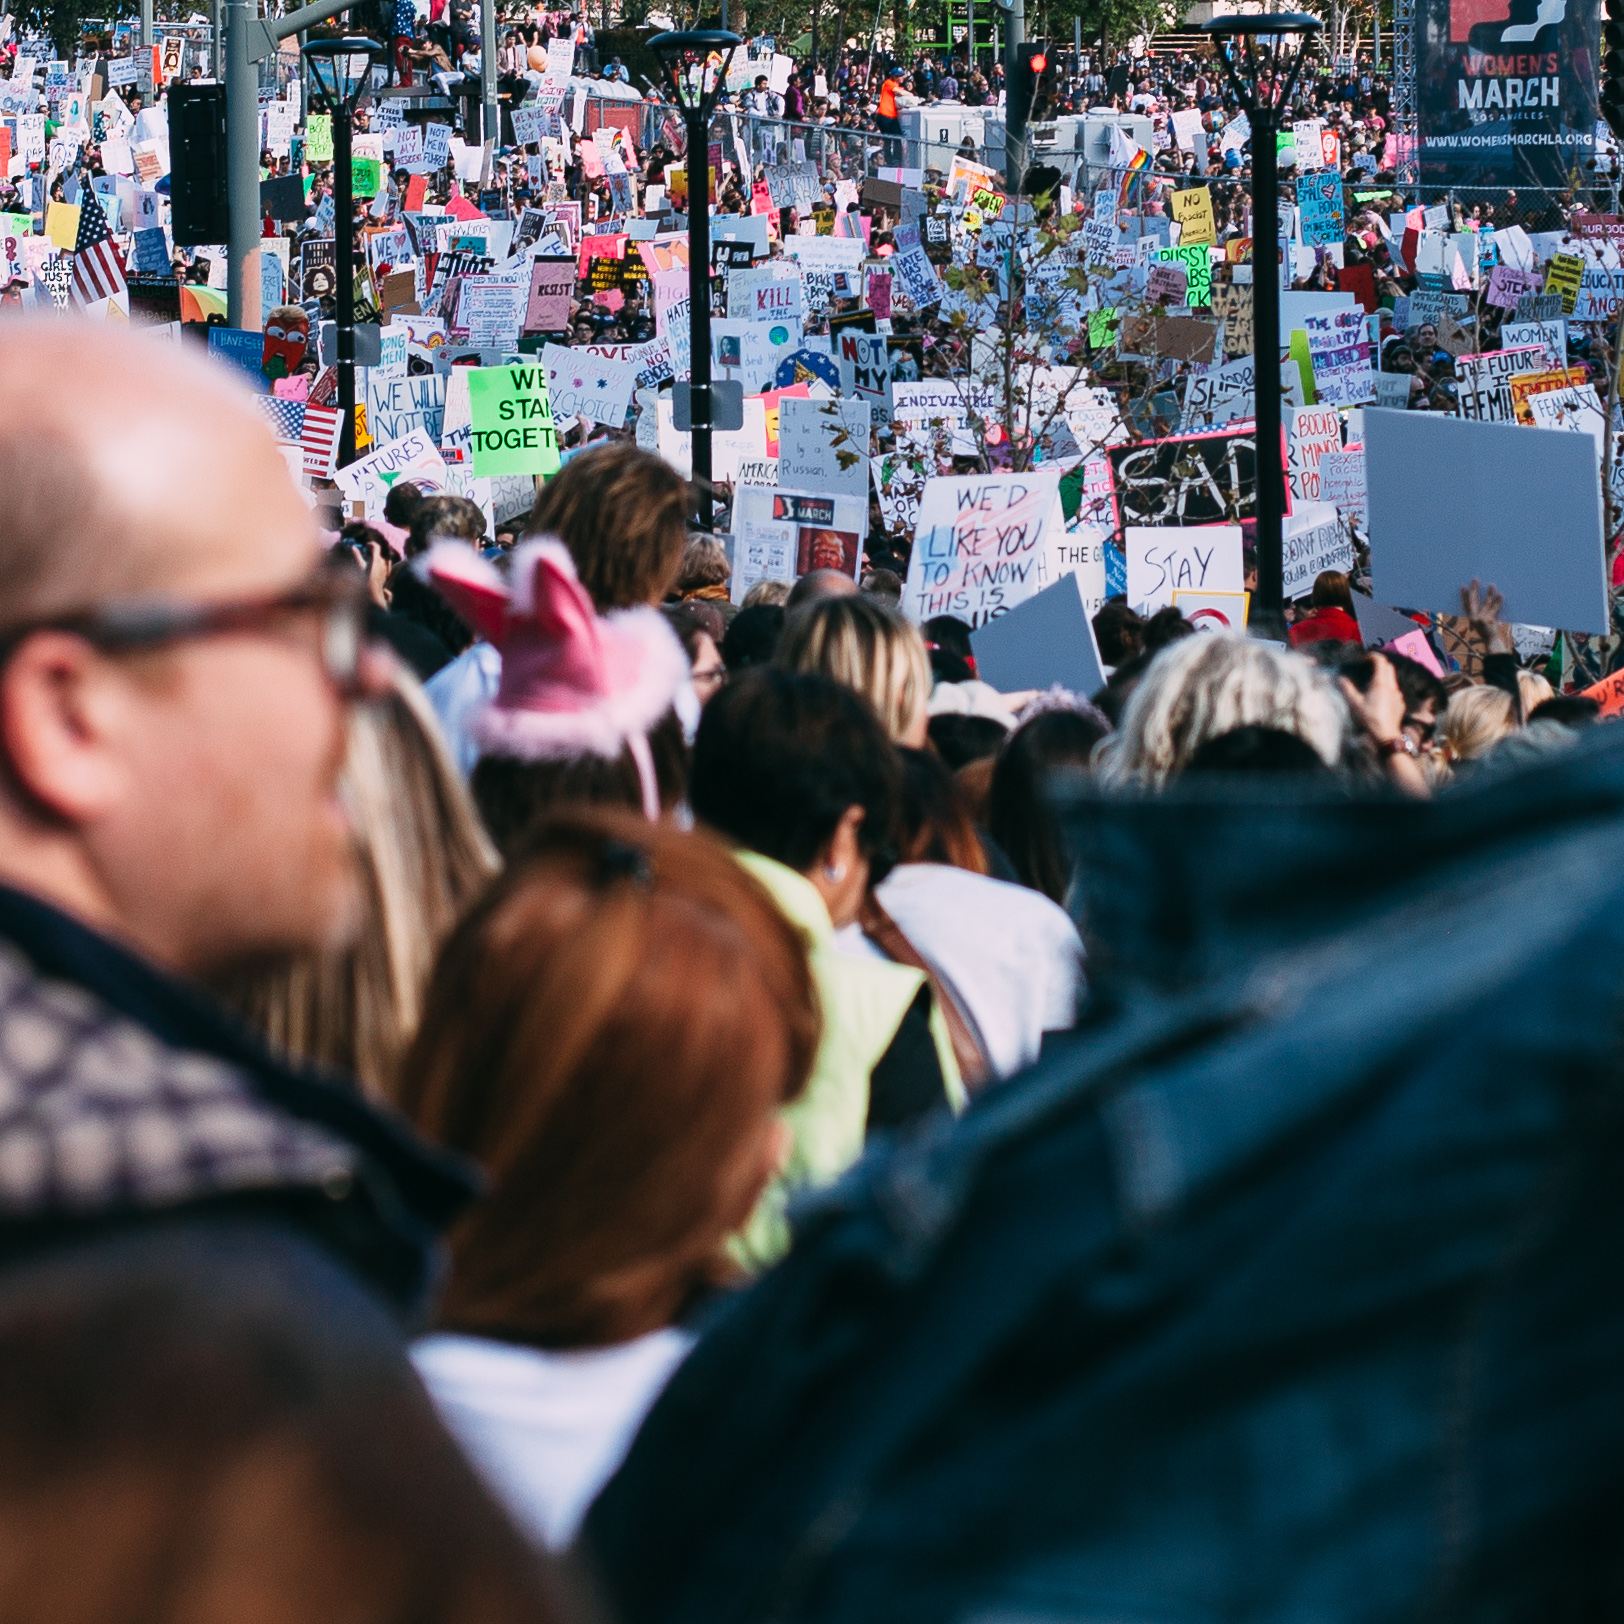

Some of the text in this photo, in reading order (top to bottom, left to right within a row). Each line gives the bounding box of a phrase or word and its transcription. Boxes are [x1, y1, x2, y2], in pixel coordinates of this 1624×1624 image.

[1462, 53, 1558, 76] WOMEN'S
[1458, 77, 1559, 109] MARCH
[397, 129, 418, 143] NOT
[429, 127, 446, 138] NOT
[400, 143, 417, 155] MY
[395, 154, 422, 165] PRESIDENT
[1297, 178, 1314, 188] BIG
[1183, 193, 1200, 208] NO
[1297, 187, 1322, 202] SMALL
[1318, 201, 1341, 214] BODY
[375, 236, 391, 258] WE
[996, 234, 1026, 252] NOPE
[40, 260, 74, 271] GIRLS
[898, 251, 924, 268] HATE
[43, 272, 72, 282] JUST
[500, 276, 517, 284] KNOW
[901, 265, 922, 280] HAS
[538, 283, 572, 297] RESIST
[756, 287, 793, 310] KILL
[1414, 291, 1460, 306] IMMIGRANTS
[212, 334, 243, 346] I HAVE
[1506, 327, 1558, 343] WOMEN
[646, 348, 671, 367] NOT
[841, 336, 883, 364] NOT
[1332, 349, 1360, 363] NEED
[637, 361, 674, 389] GENDER
[1457, 360, 1485, 376] THE
[510, 369, 546, 390] WE
[854, 365, 887, 391] MY
[373, 377, 444, 412] WE WILL
[897, 394, 994, 408] INDIVISIBLE
[562, 388, 619, 425] CHOICE
[1298, 411, 1339, 438] BODIES
[352, 436, 425, 484] NATURES
[1329, 453, 1364, 465] sexist
[782, 459, 825, 476] Russian
[1330, 465, 1364, 474] racist
[957, 485, 1029, 511] WE'D
[797, 508, 831, 521] MARCH
[928, 520, 1042, 557] LIKE YOU
[1057, 546, 1089, 564] THE
[919, 558, 1035, 588] TO KNOW
[1144, 546, 1215, 596] STAY
[917, 587, 1005, 615] THIS IS
